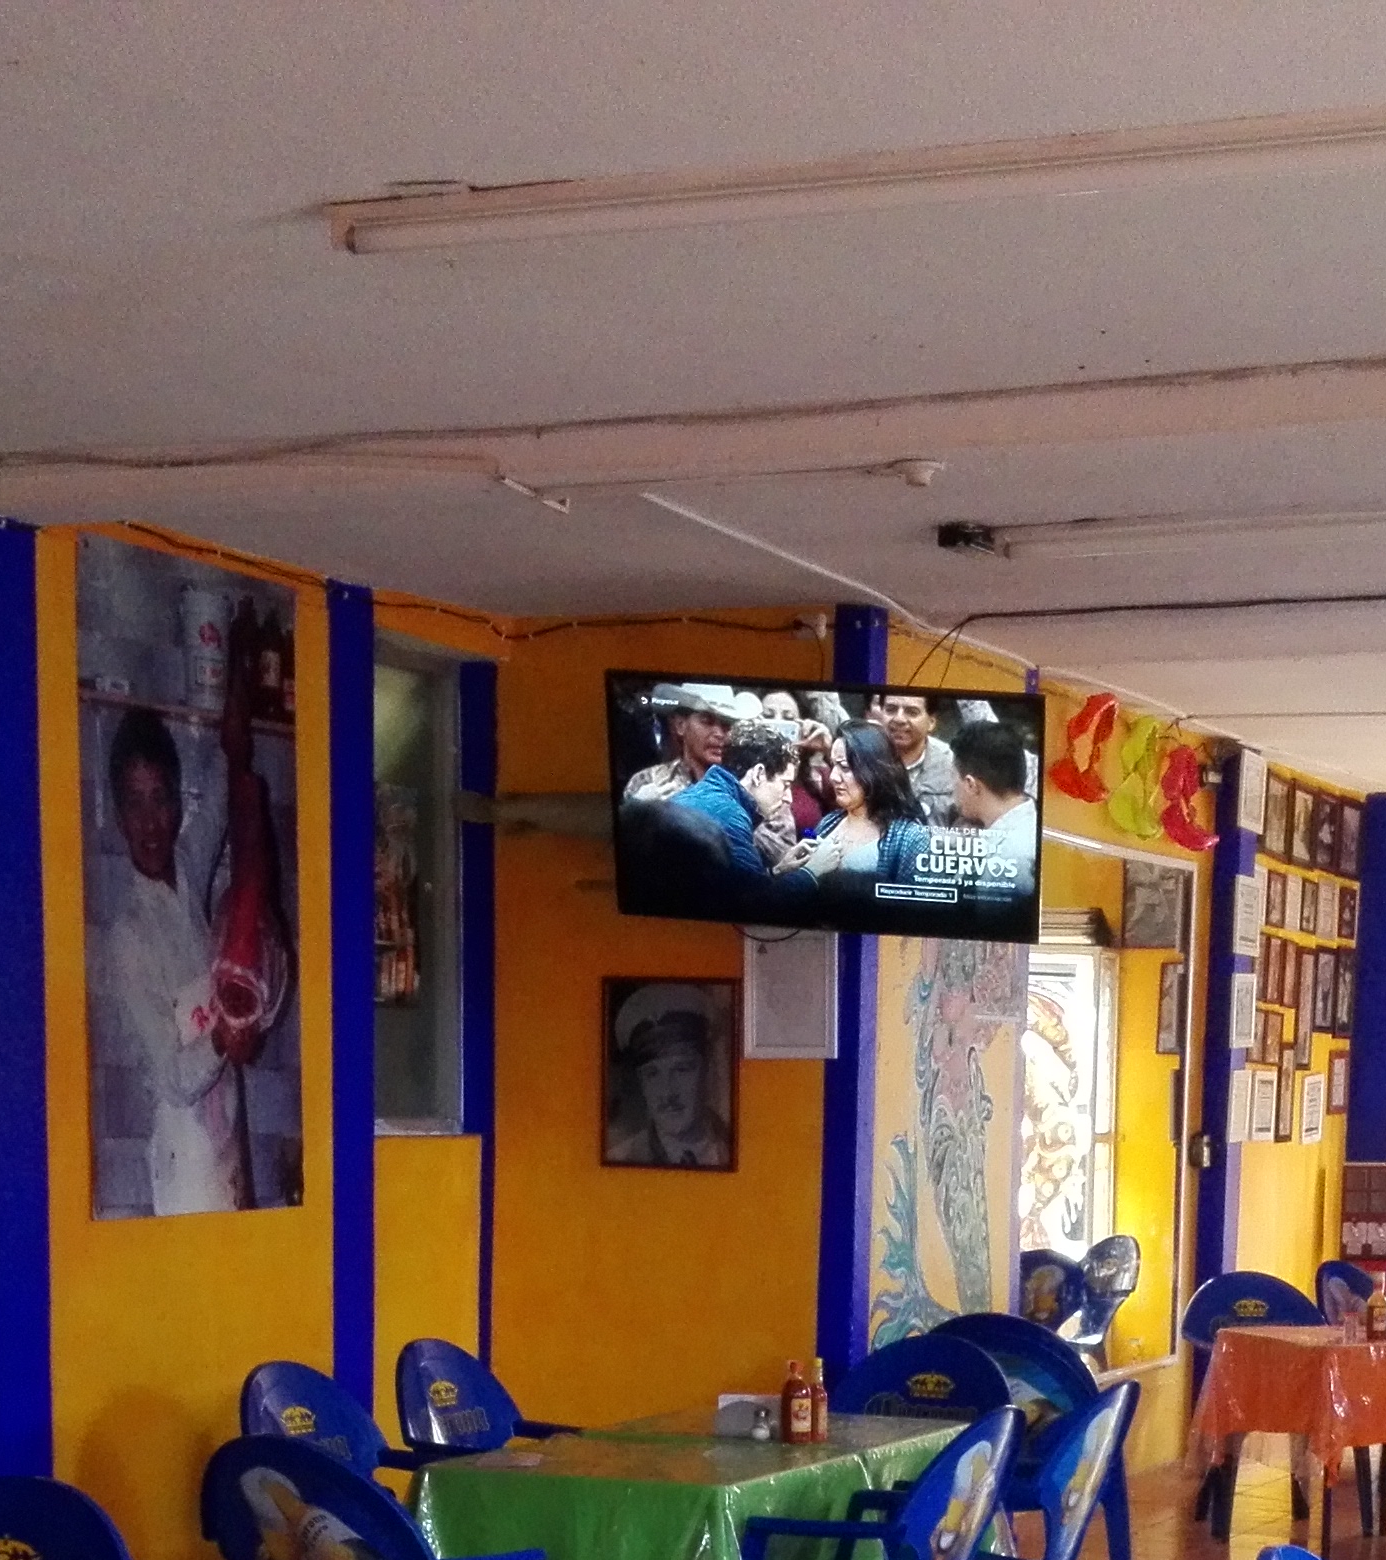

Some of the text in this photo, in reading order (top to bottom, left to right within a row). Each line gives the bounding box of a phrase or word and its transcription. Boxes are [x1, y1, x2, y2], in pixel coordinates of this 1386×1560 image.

[963, 827, 976, 836] DE
[930, 836, 988, 857] CLUB
[915, 853, 1018, 878] CUERVOS
[975, 879, 1016, 889] disponible
